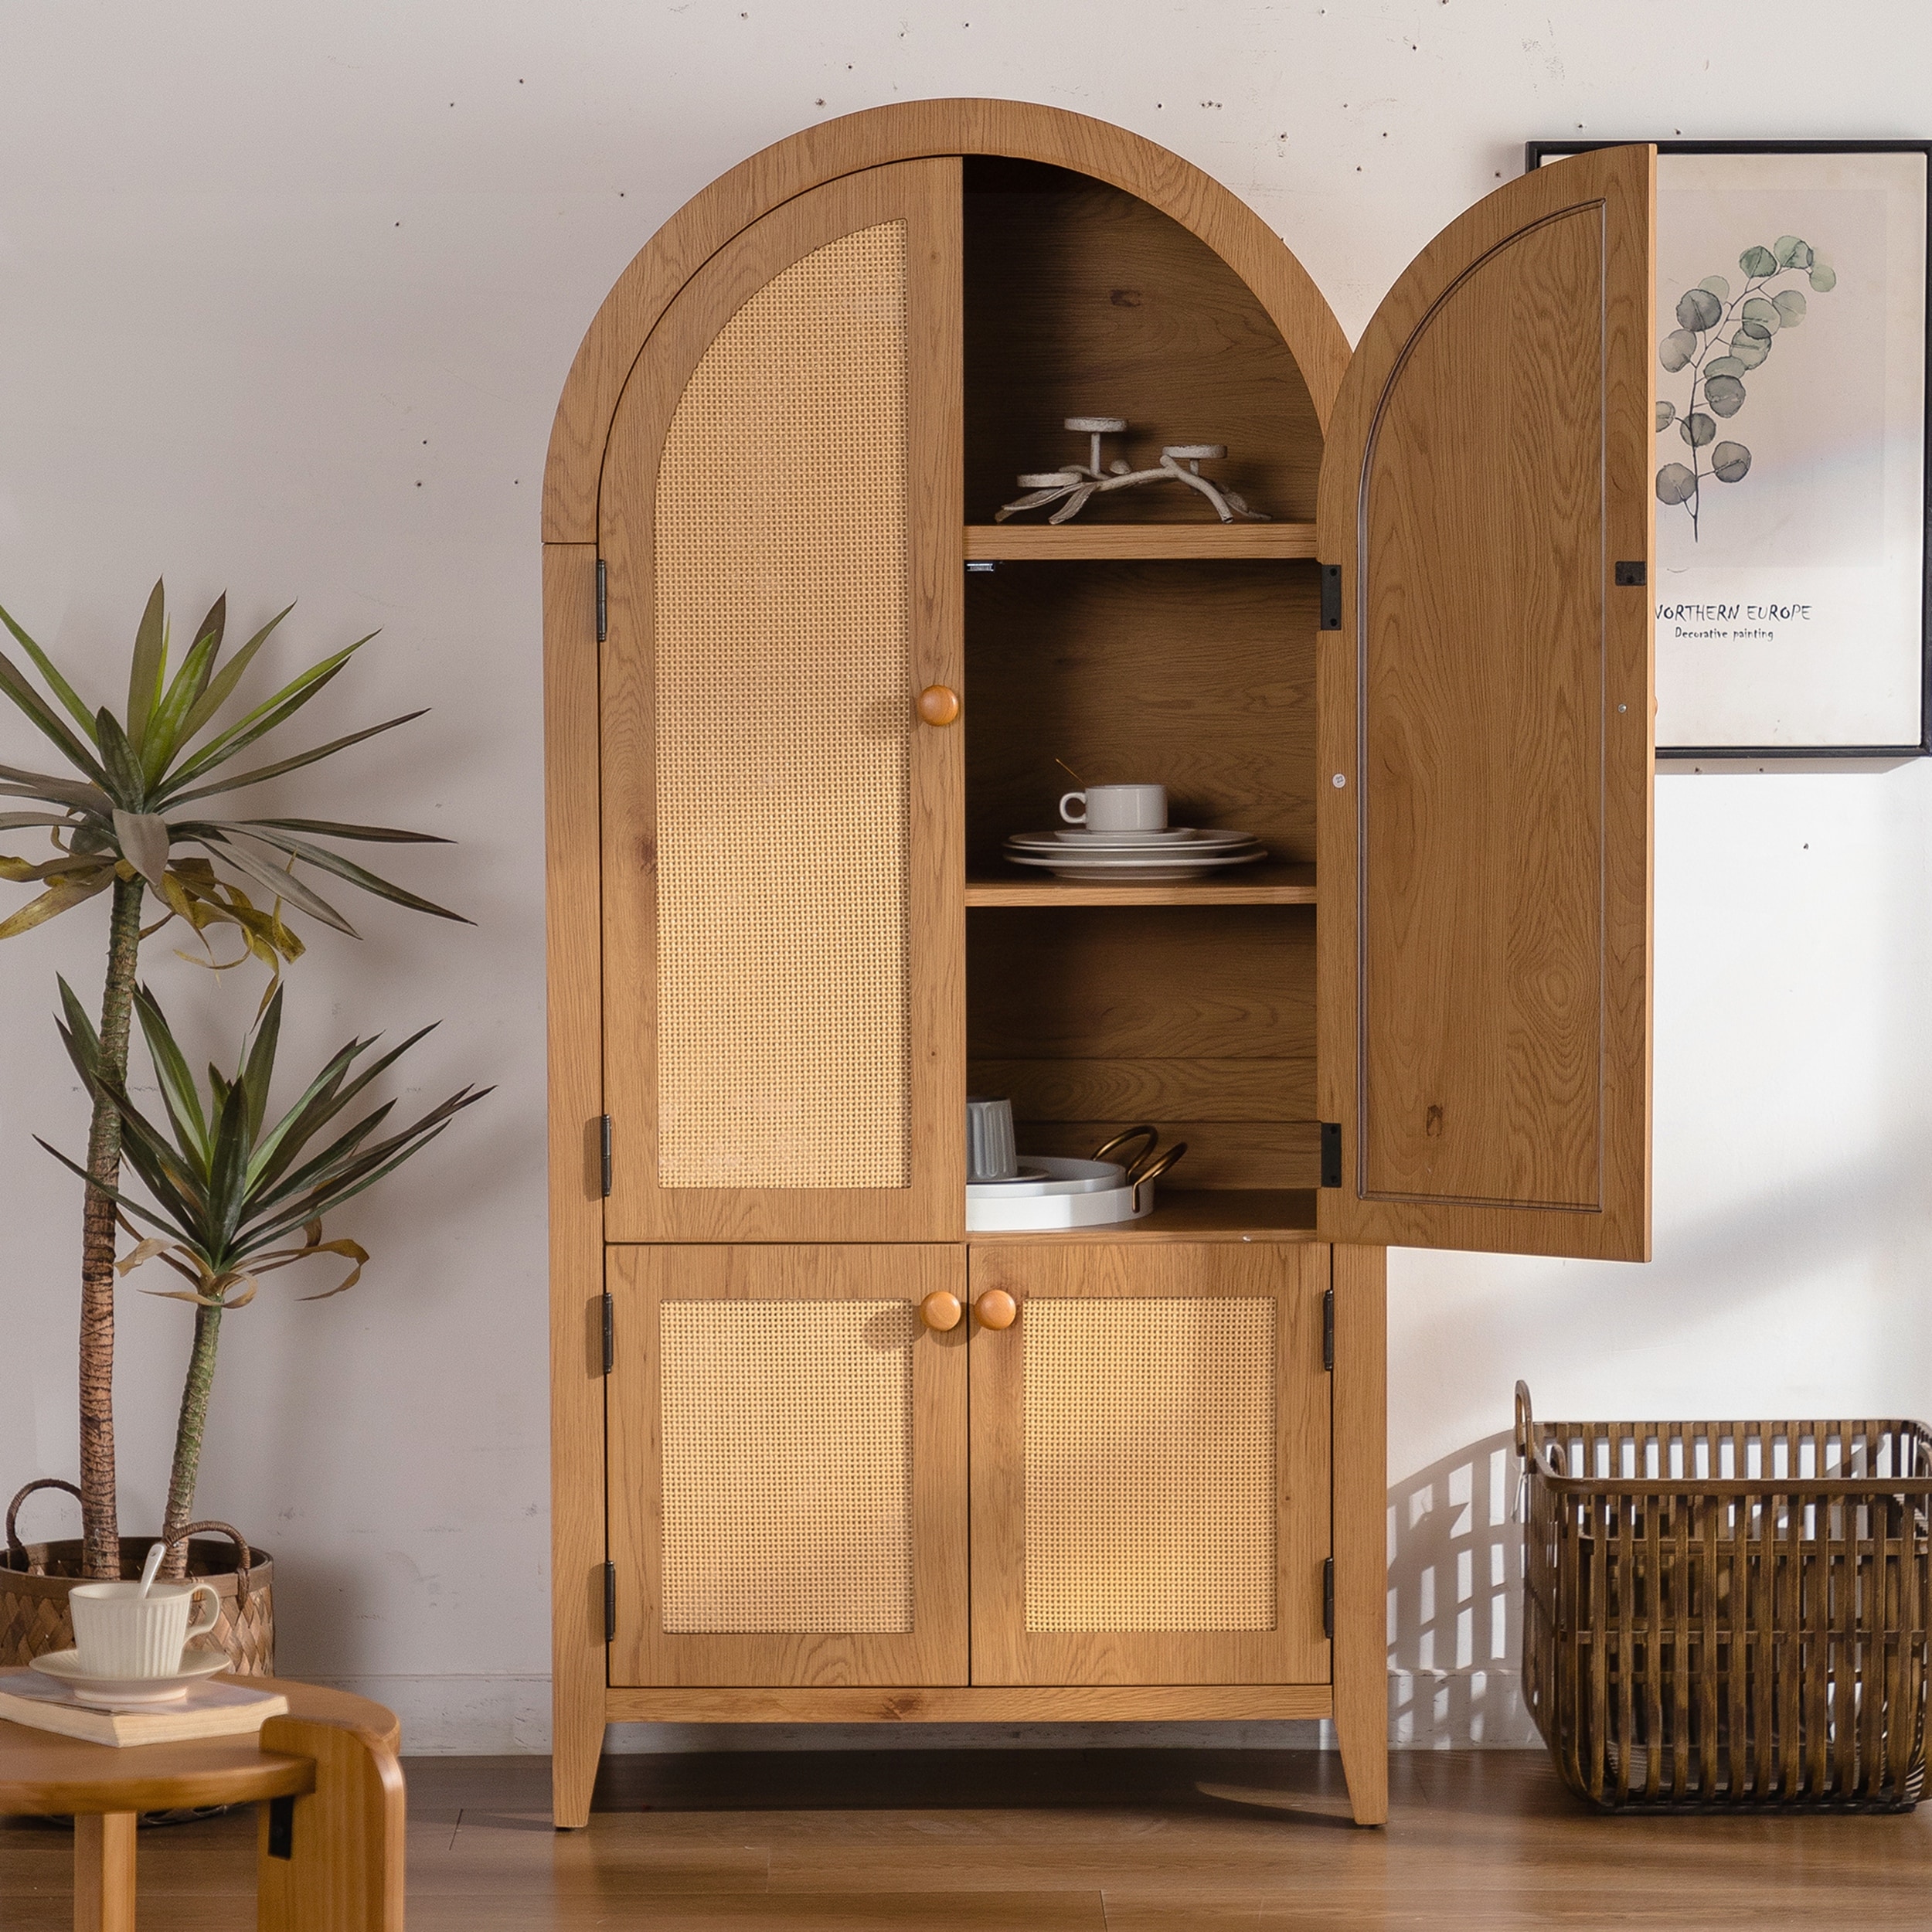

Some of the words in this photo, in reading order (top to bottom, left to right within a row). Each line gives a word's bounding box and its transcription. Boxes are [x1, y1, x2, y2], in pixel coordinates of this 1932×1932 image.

[1747, 604, 1812, 621] EUROPE
[1675, 627, 1728, 638] Decorative
[1733, 628, 1774, 641] painting
